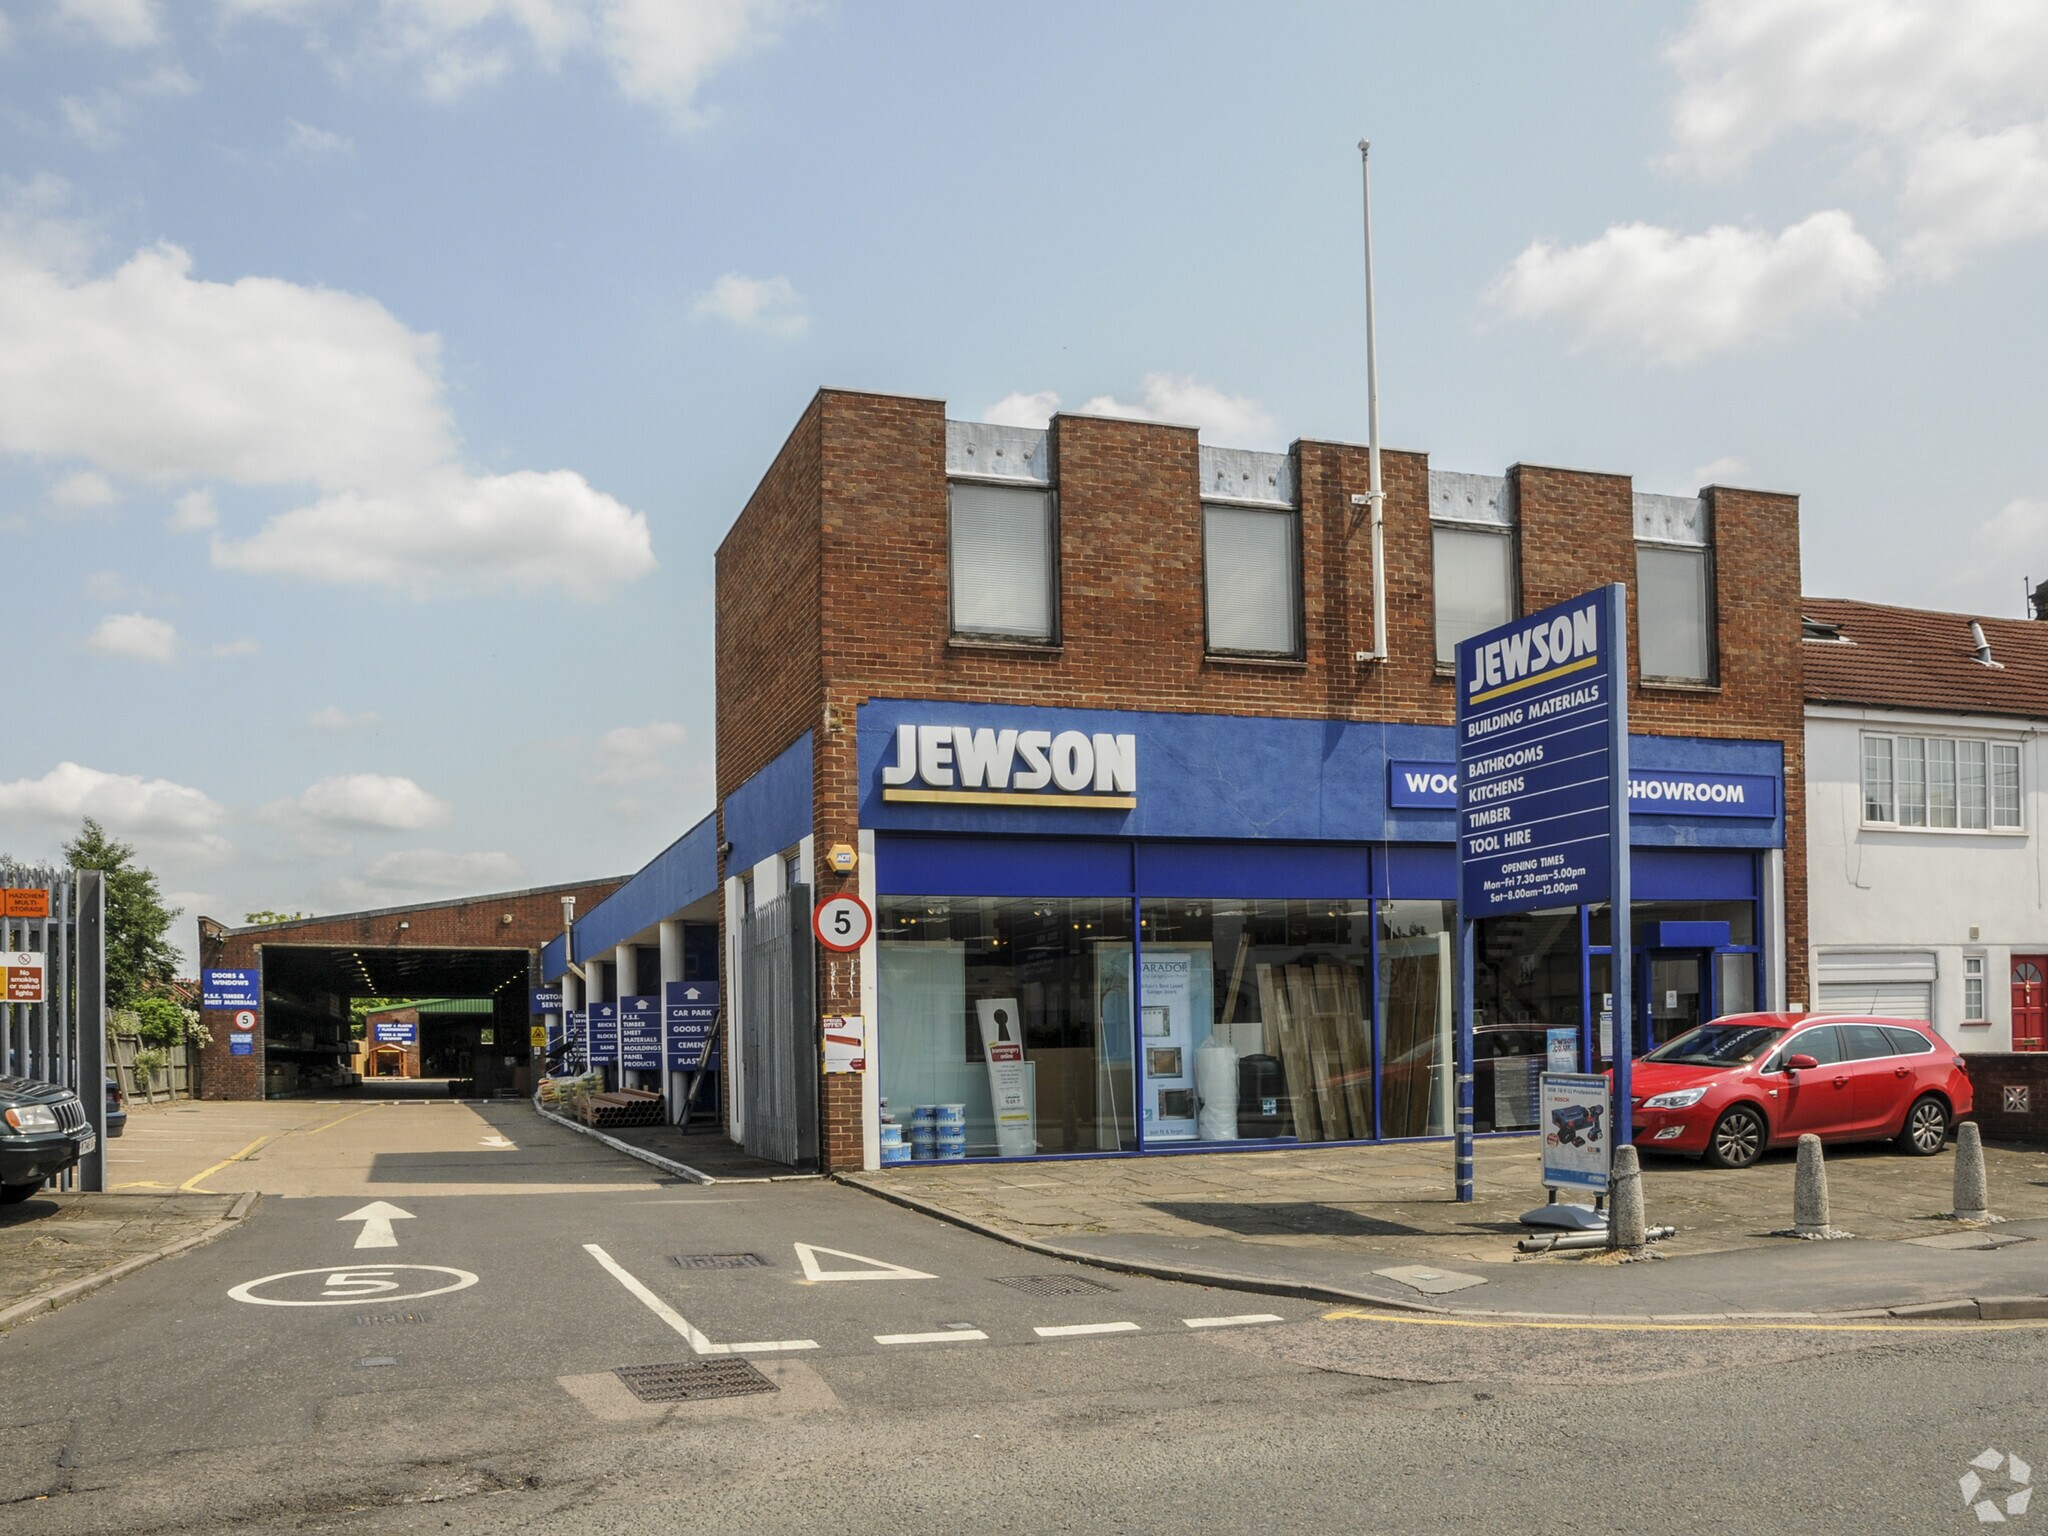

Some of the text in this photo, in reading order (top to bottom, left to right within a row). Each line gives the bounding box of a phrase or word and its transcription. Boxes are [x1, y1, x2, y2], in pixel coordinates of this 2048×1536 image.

[1469, 604, 1598, 694] JEWSON
[1468, 684, 1600, 738] BUILDING MATERIALS
[882, 724, 1137, 793] JEWSON
[1468, 744, 1544, 779] BATHROOMS
[1468, 776, 1526, 803] KITCHENS
[1469, 806, 1511, 828] TIMBER
[1469, 828, 1532, 854] TOOL HIRE
[1501, 854, 1565, 874] OPENING TIMES
[833, 910, 852, 935] 5
[1142, 963, 1188, 972] ARADOR
[10, 976, 39, 984] smoking
[15, 989, 34, 997] lights
[241, 1015, 249, 1025] 5
[673, 1009, 688, 1017] CAR
[673, 1025, 701, 1033] GOODS
[320, 1271, 400, 1296] 5
